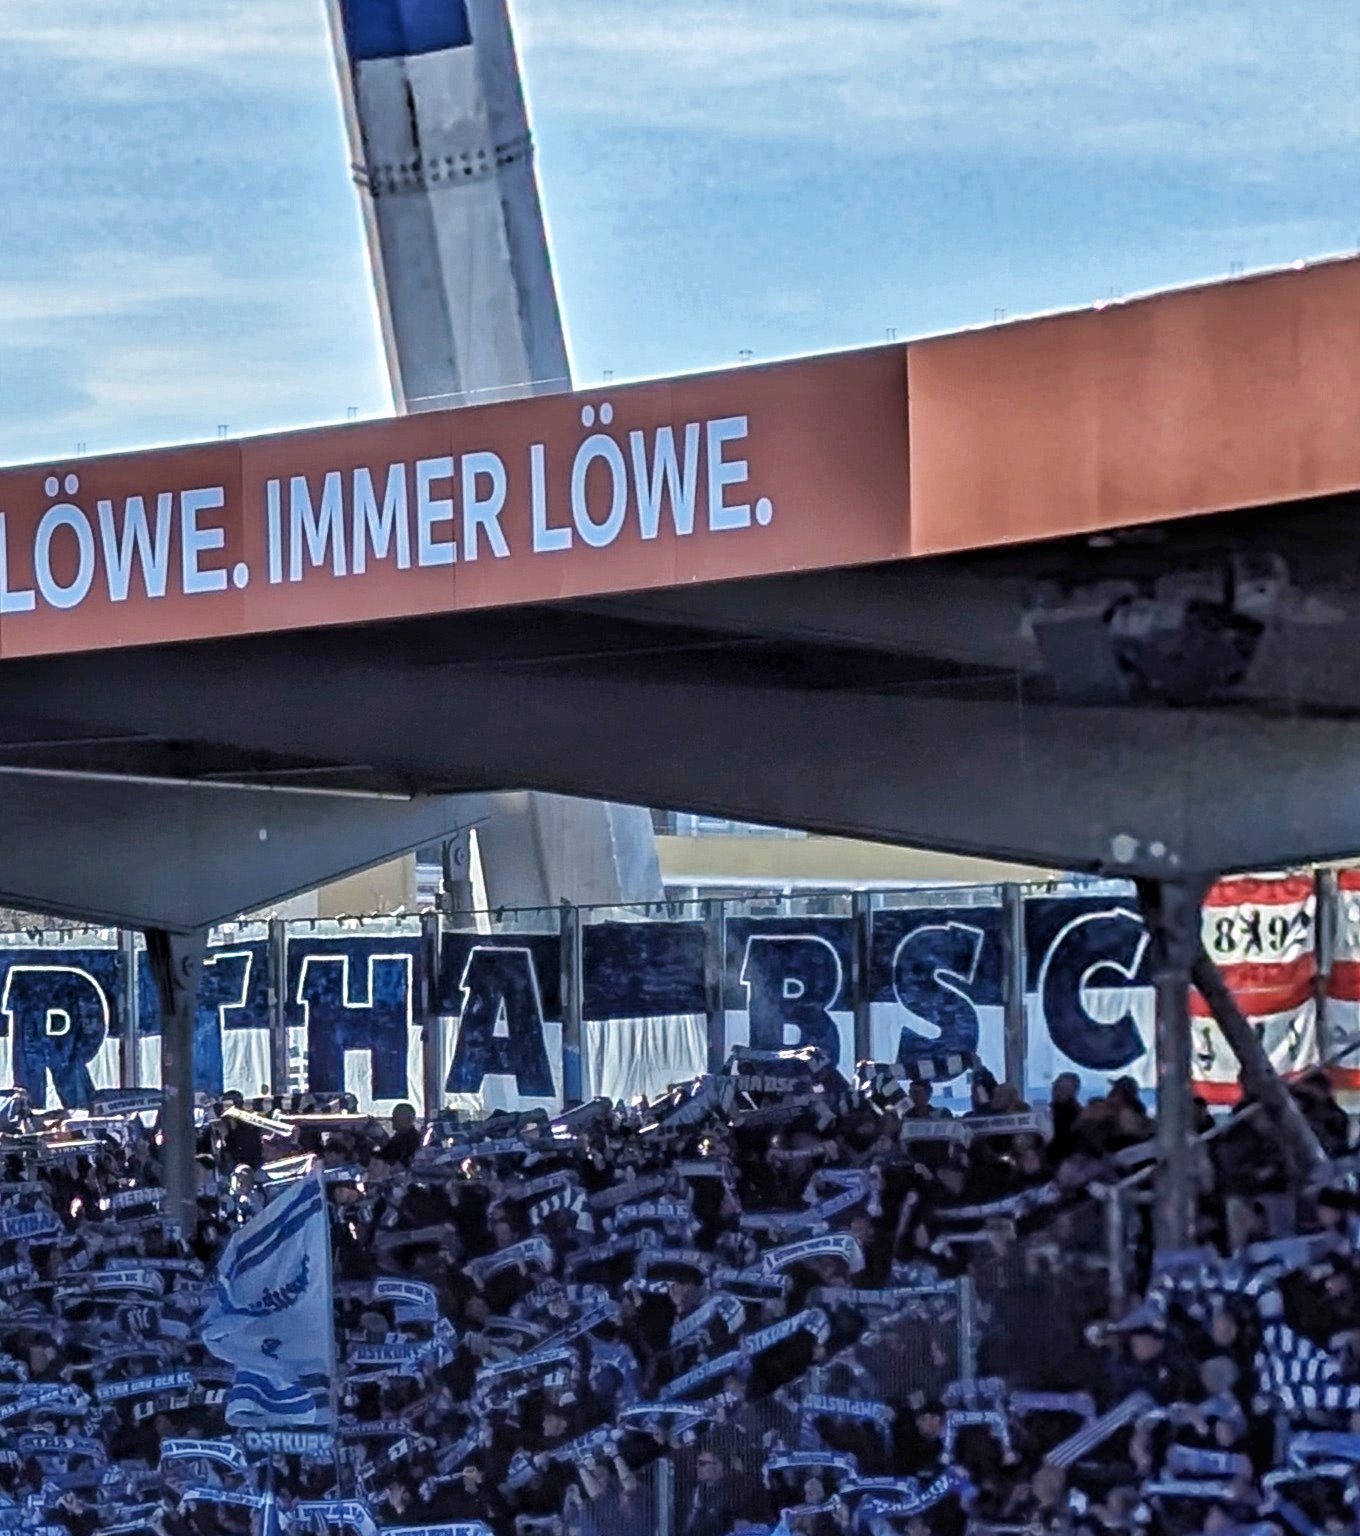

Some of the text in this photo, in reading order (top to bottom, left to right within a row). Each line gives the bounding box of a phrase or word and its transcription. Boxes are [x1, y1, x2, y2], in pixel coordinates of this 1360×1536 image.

[267, 449, 509, 583] IMMER
[531, 401, 773, 553] LÖWE.
[741, 909, 1150, 1072] BSC
